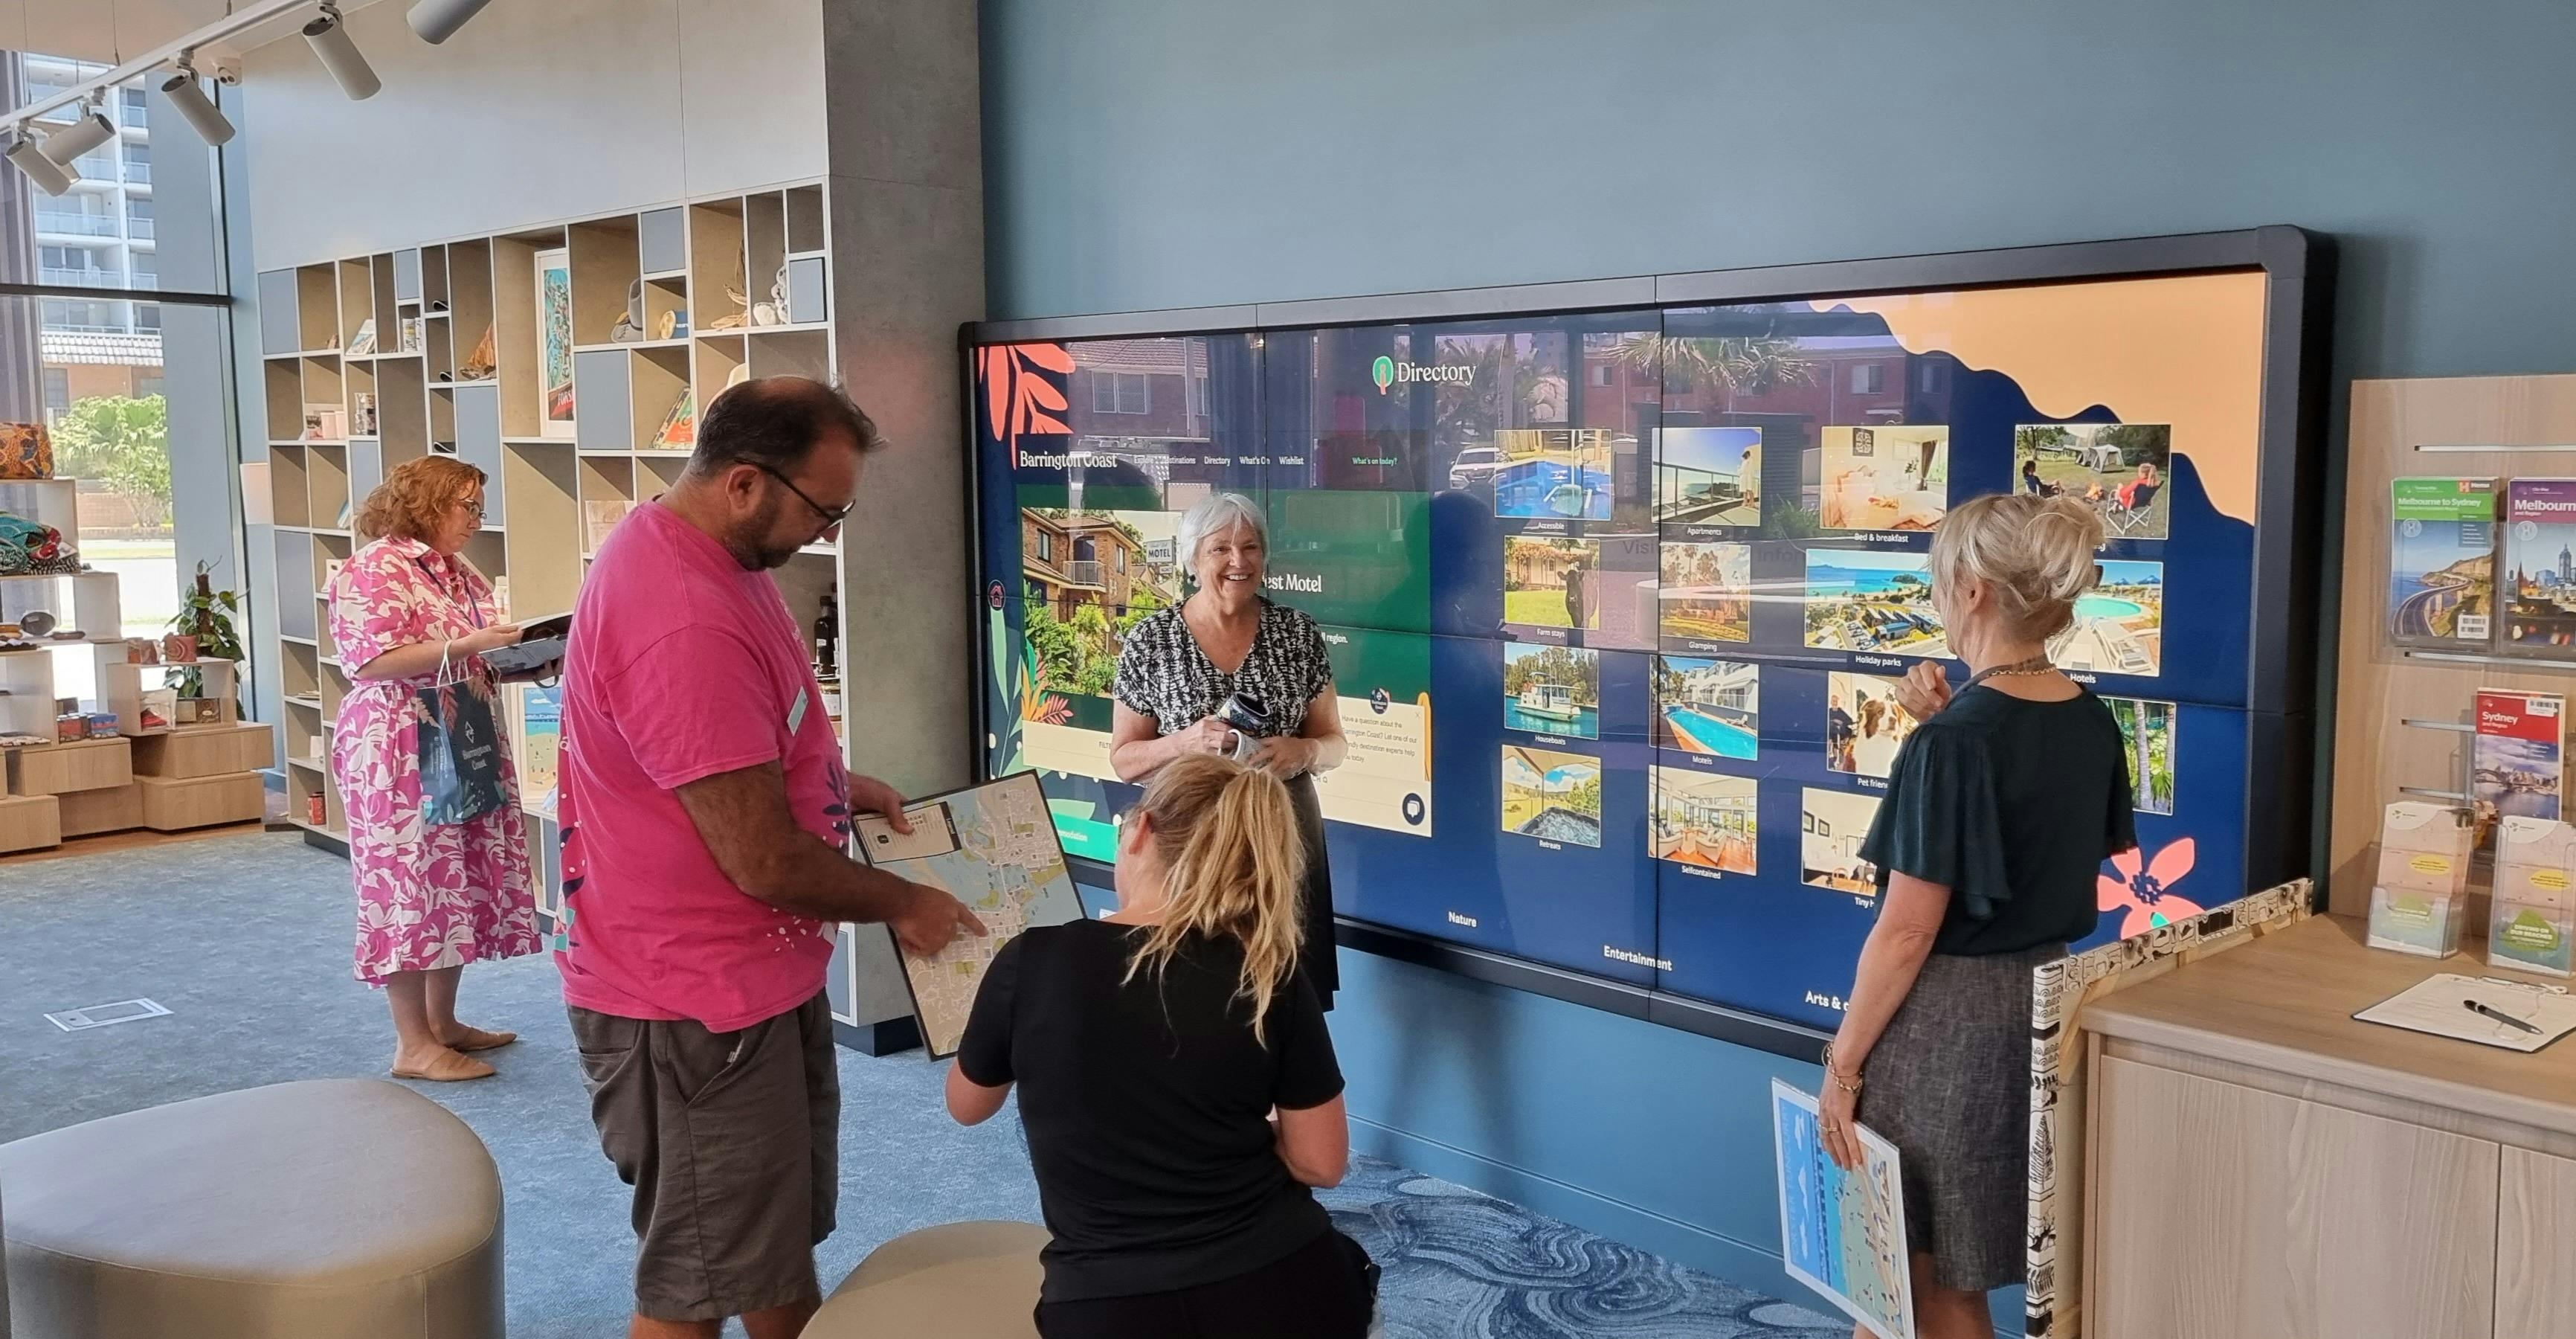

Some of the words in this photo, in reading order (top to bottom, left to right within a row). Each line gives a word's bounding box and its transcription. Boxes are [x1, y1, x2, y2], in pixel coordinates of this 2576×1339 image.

[1397, 362, 1476, 386] Directory
[1020, 450, 1081, 470] Barrington
[1083, 451, 1118, 468] Coast
[1204, 455, 1231, 467] Directory
[1239, 455, 1260, 465] What's
[1278, 455, 1304, 465] Wishlist
[2398, 497, 2441, 506] Melbourne
[2442, 498, 2451, 506] to
[2452, 498, 2482, 508] Sydney
[2514, 499, 2576, 512] Melbourn
[1687, 527, 1722, 536] Apartments
[1854, 533, 1868, 542] Bed
[1869, 533, 1875, 542] &
[1875, 533, 1910, 543] breakfast
[1147, 548, 1171, 559] MOTEL
[1285, 573, 1322, 593] Motel
[1536, 628, 1551, 637] Farm
[1551, 630, 1565, 639] stays
[1688, 640, 1718, 652] Glamping
[1855, 655, 1881, 667] Holiday
[1881, 658, 1902, 667] parks
[2070, 672, 2097, 684] Hotels
[2482, 710, 2519, 726] Sydney
[1098, 741, 1112, 750] FILTE
[1534, 734, 1566, 745] Houseboats
[1692, 755, 1713, 765] Motels
[1857, 777, 1869, 787] Pet
[1870, 778, 1888, 789] frien
[1539, 839, 1561, 850] Retreats
[1681, 864, 1722, 879] Selfcontained
[1855, 896, 1870, 909] Tiny
[1448, 911, 1478, 928] Nature
[1603, 944, 1673, 972] Entertainment
[1804, 989, 1830, 1008] Arts
[1831, 995, 1841, 1010] &
